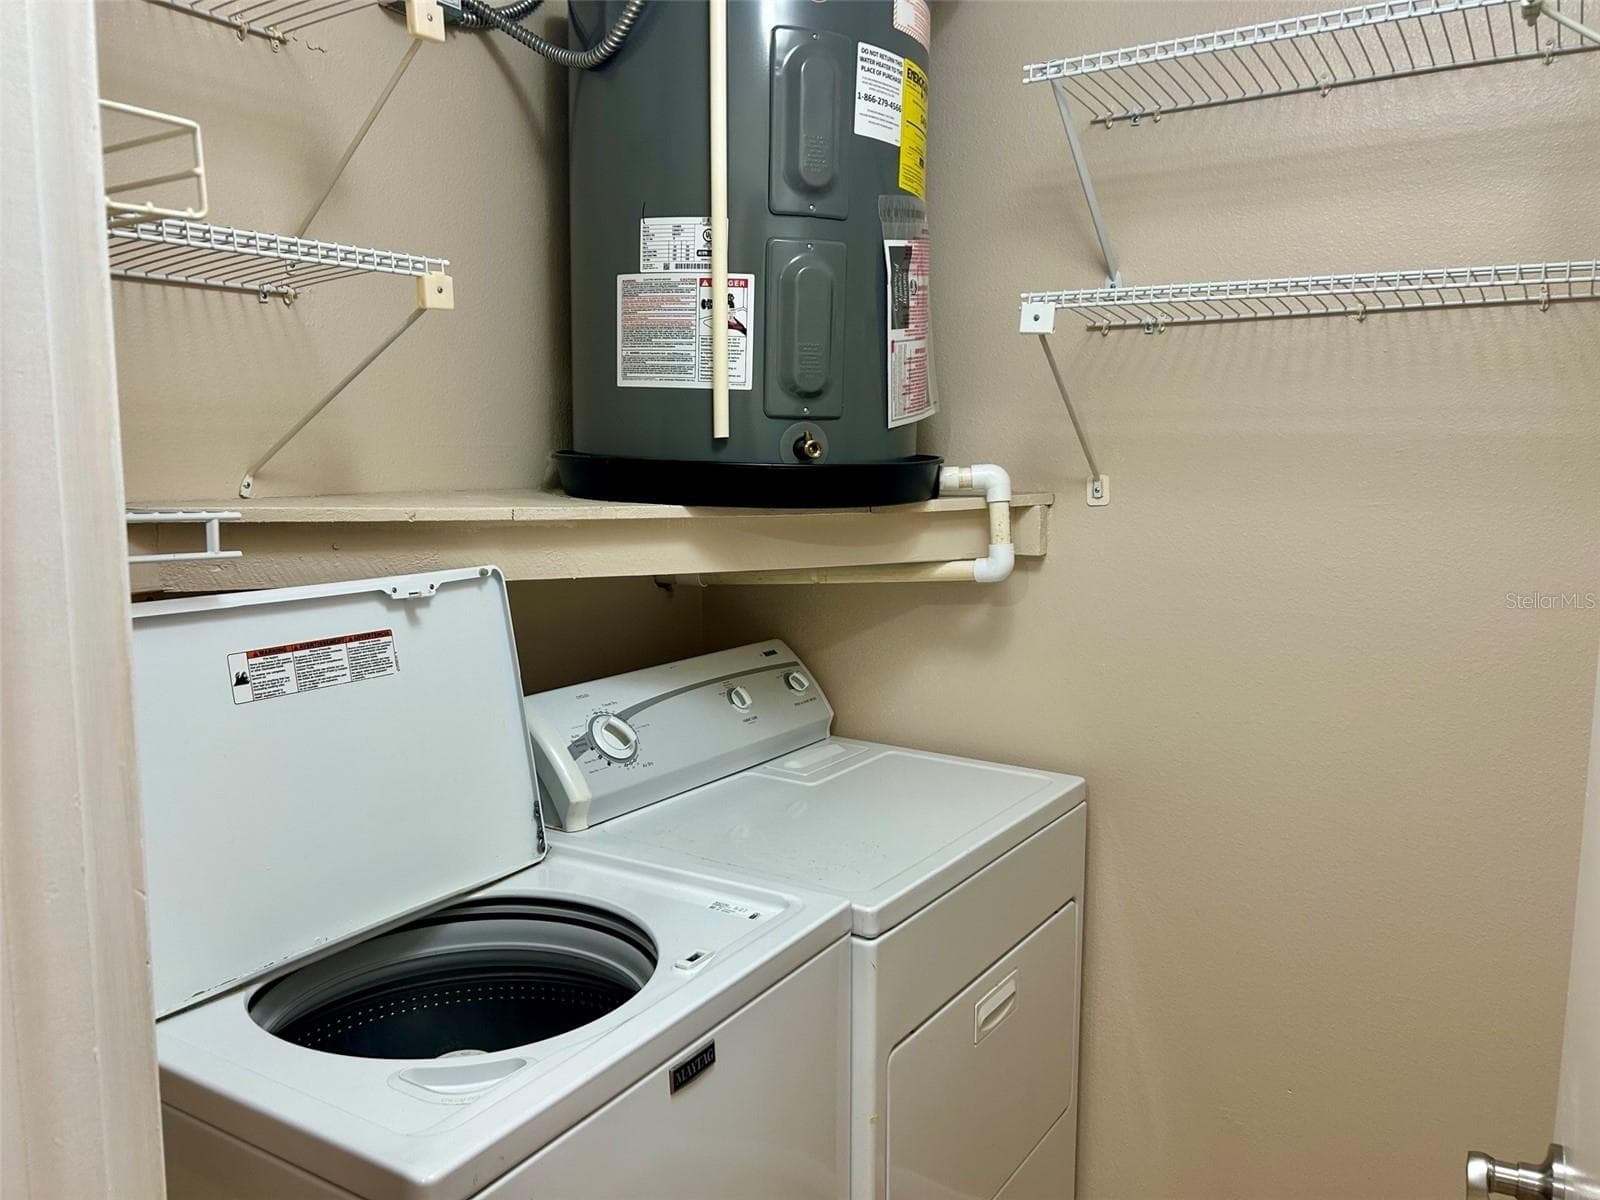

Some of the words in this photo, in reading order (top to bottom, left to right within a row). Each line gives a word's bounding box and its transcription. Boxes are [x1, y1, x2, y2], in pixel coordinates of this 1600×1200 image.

[860, 56, 875, 65] WATER
[876, 60, 891, 71] HEATER
[861, 47, 869, 55] DO
[870, 49, 879, 57] NOT
[879, 52, 894, 64] RETURN
[894, 59, 903, 67] THIS
[861, 65, 875, 75] PLACE
[882, 72, 902, 84] PURCHASE
[857, 91, 902, 113] 1-866-279-4566
[675, 1047, 714, 1087] MAYTAG
